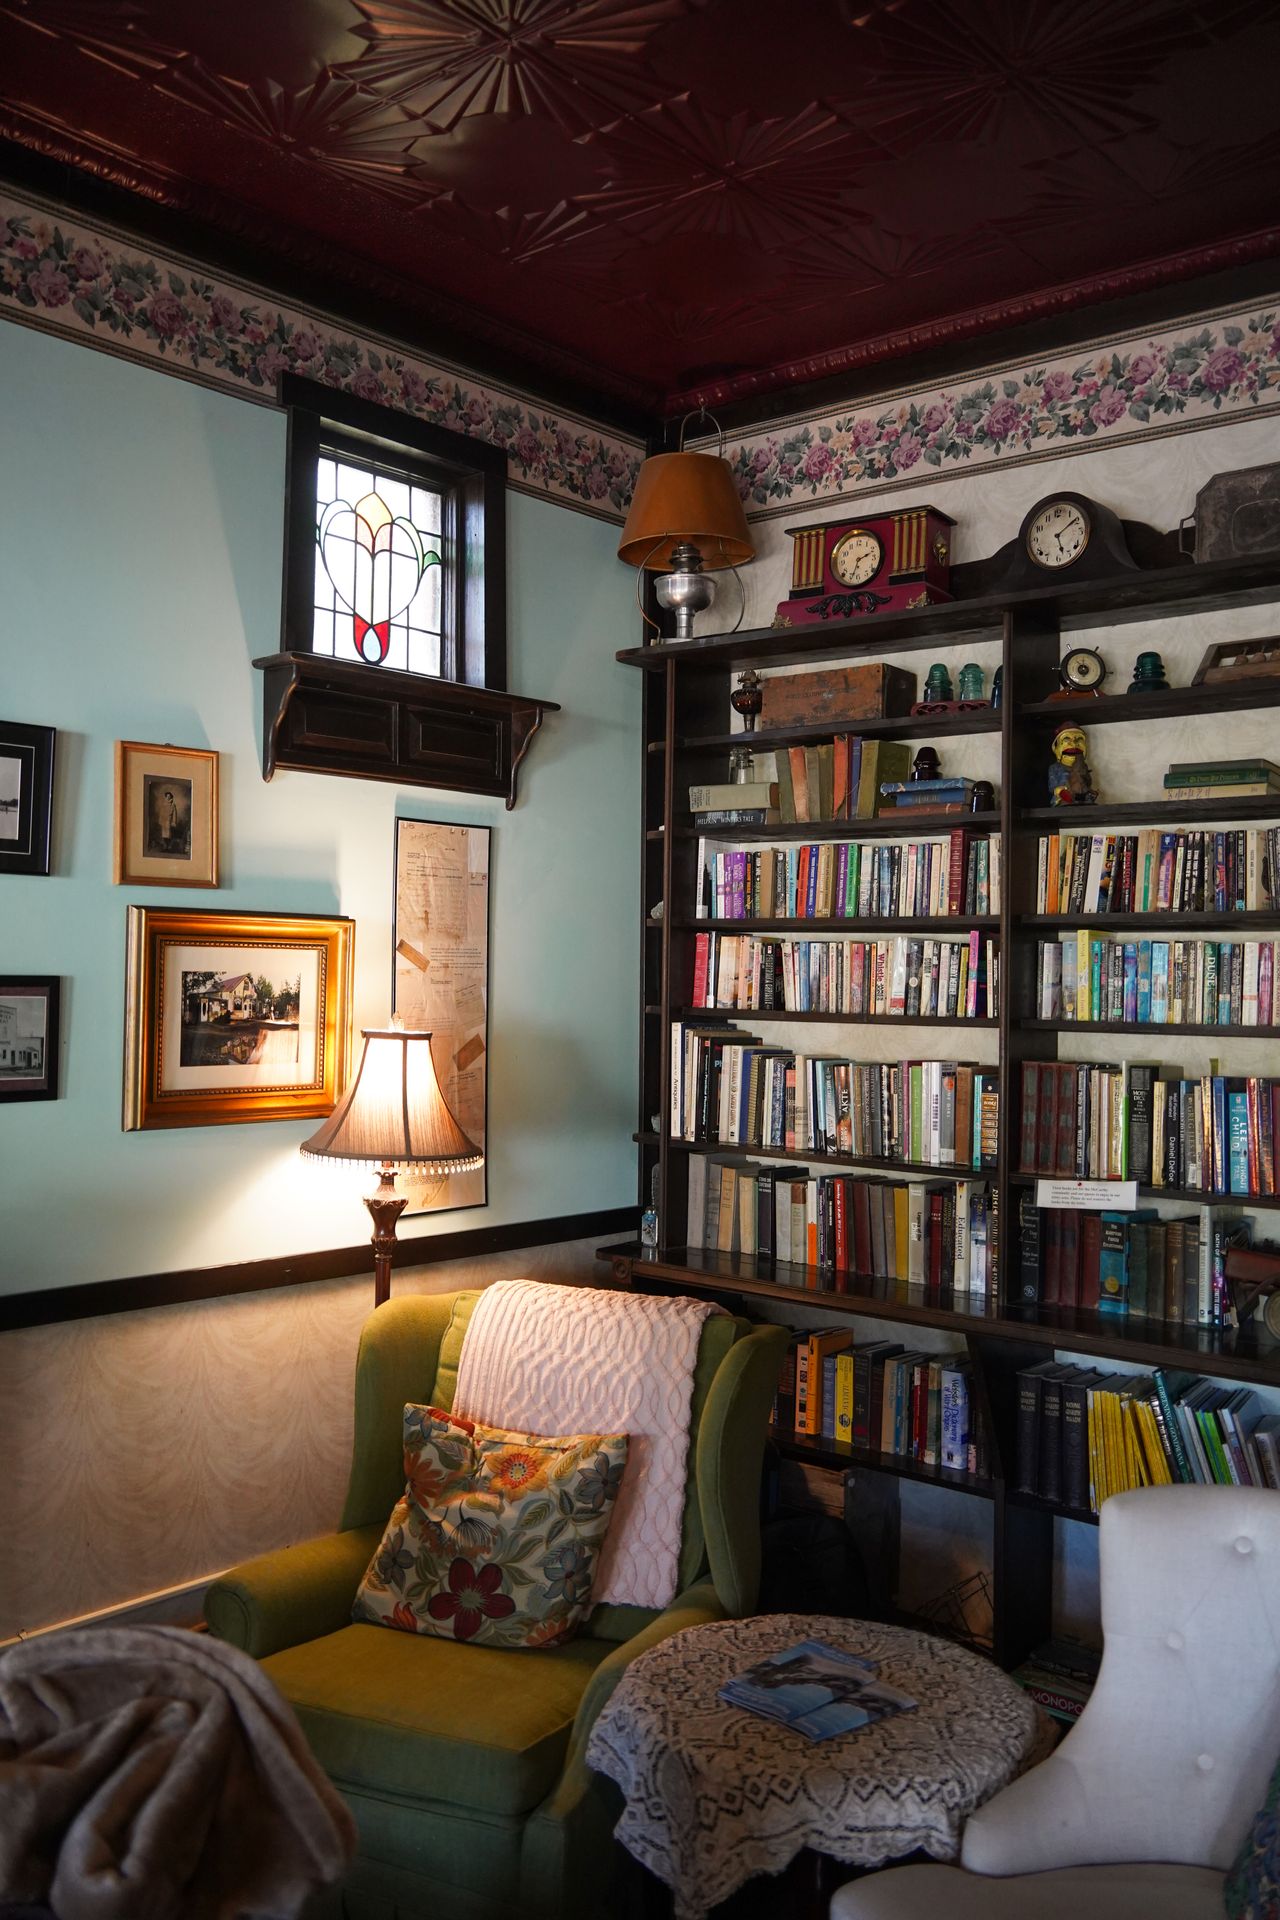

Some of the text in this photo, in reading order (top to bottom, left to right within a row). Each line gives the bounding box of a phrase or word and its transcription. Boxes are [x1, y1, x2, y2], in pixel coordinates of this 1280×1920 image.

[1079, 848, 1087, 884] Youngblood
[877, 953, 885, 981] Whistle
[1168, 1137, 1176, 1182] Daniel Defoe
[957, 1216, 965, 1260] Educated
[950, 1379, 959, 1441] Webster's Dictionary
[1158, 1386, 1172, 1422] GREENING
[1170, 1427, 1185, 1466] GONDWANA
[1032, 1689, 1084, 1715] MONOPO
